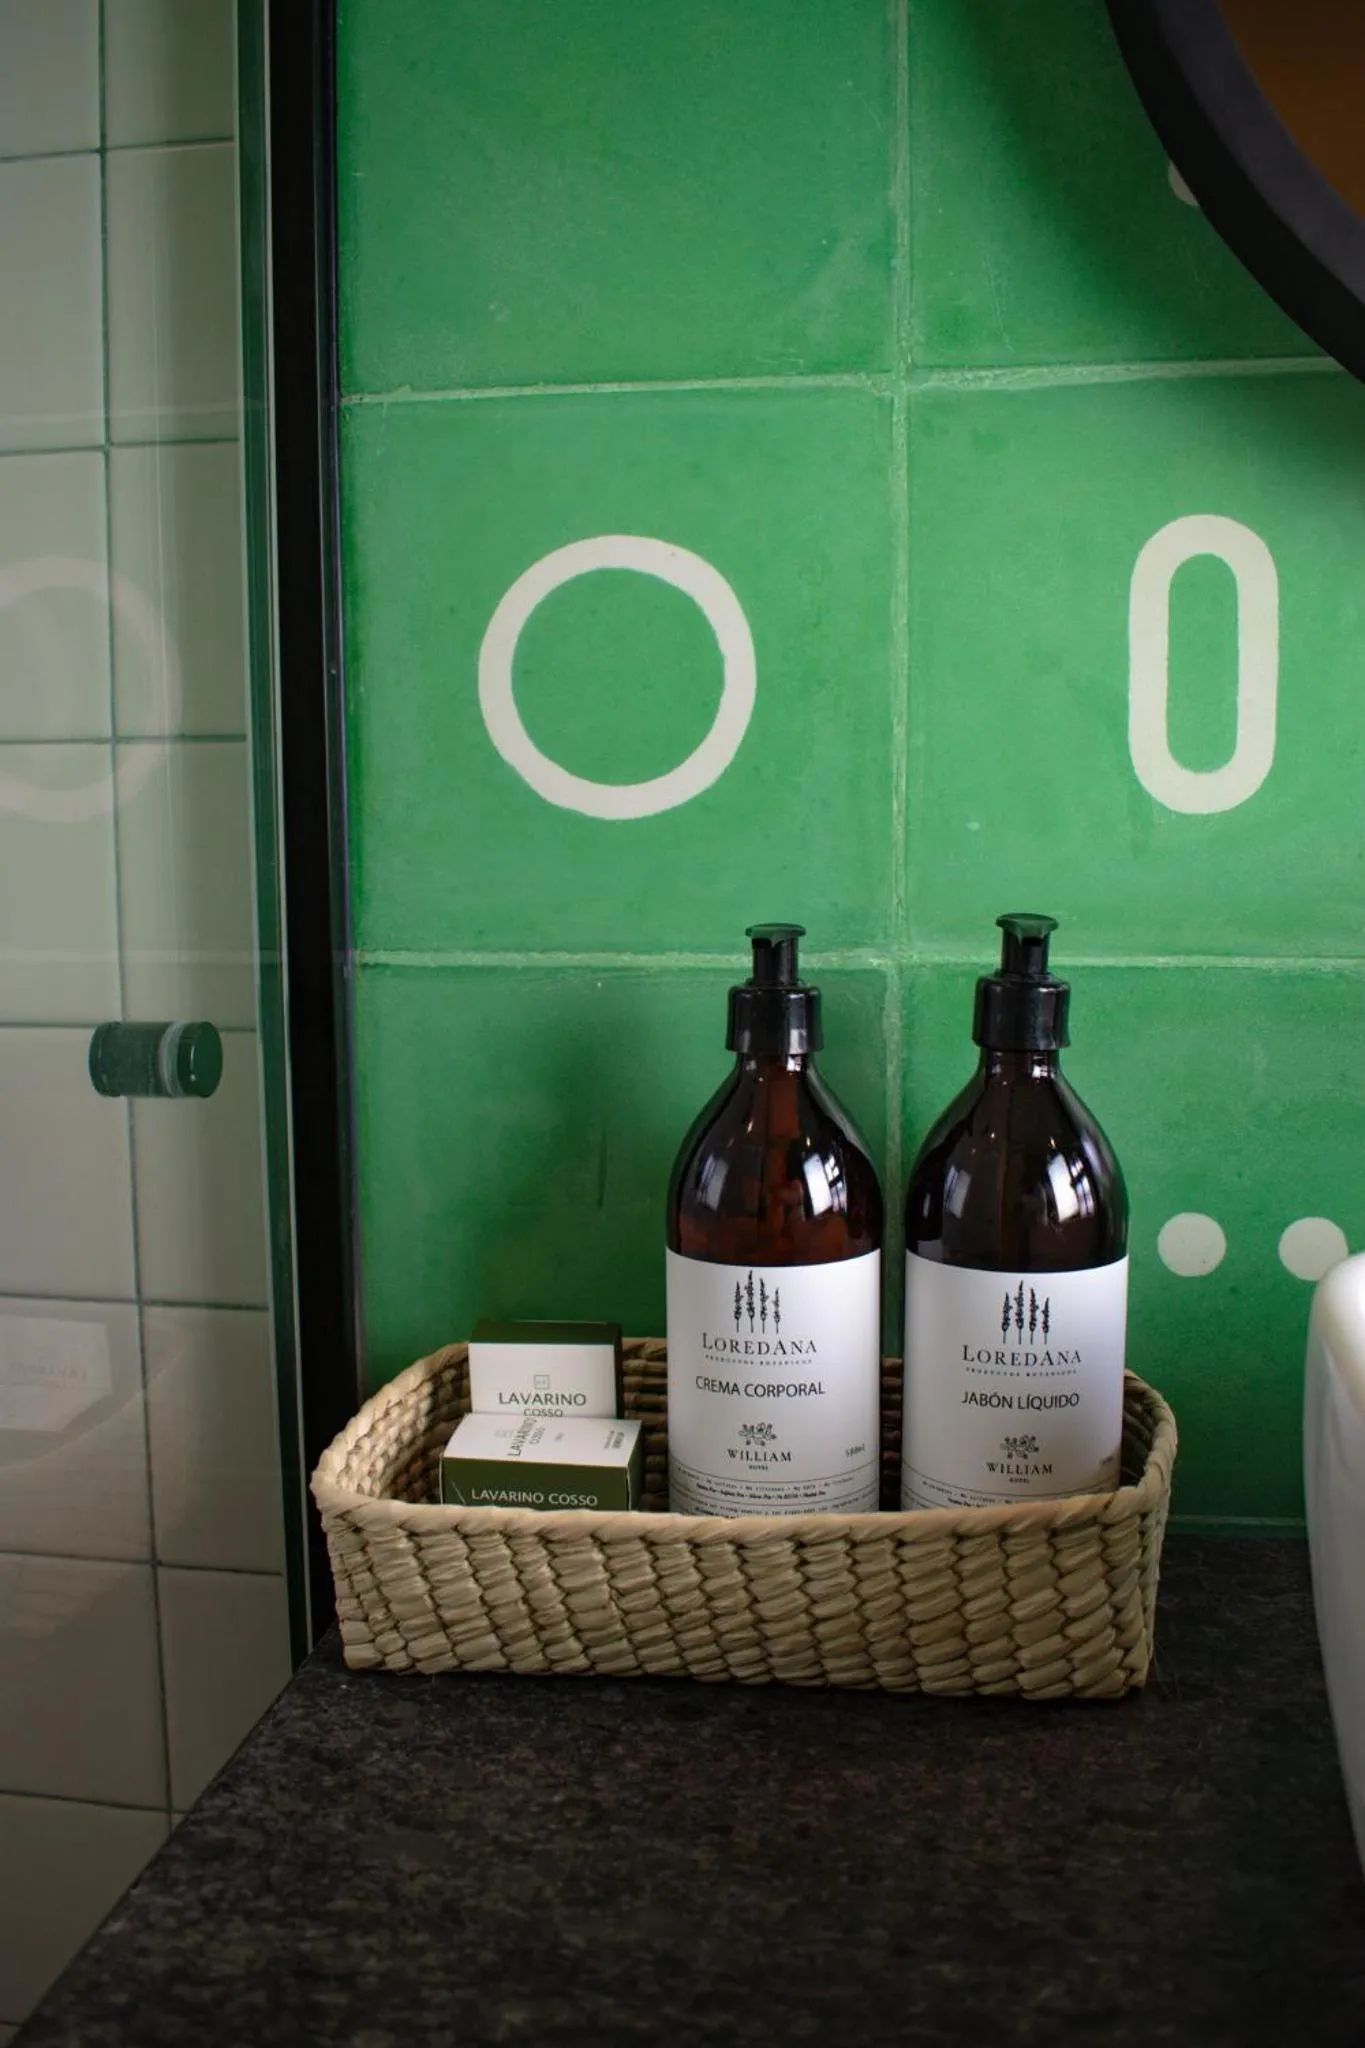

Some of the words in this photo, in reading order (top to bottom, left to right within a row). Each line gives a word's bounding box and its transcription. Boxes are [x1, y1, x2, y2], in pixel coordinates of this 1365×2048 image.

[696, 1375, 740, 1396] CREMA
[744, 1381, 826, 1398] CORPORAL
[498, 1392, 587, 1406] LAVARINO
[961, 1390, 1013, 1409] JABÓN
[1017, 1391, 1081, 1411] LÍQUIDO
[523, 1408, 563, 1418] COSSO
[726, 1448, 792, 1463] WILLIAM
[985, 1461, 1053, 1475] WILLIAM
[471, 1487, 544, 1504] LAVARINO
[548, 1493, 599, 1506] COSSO
